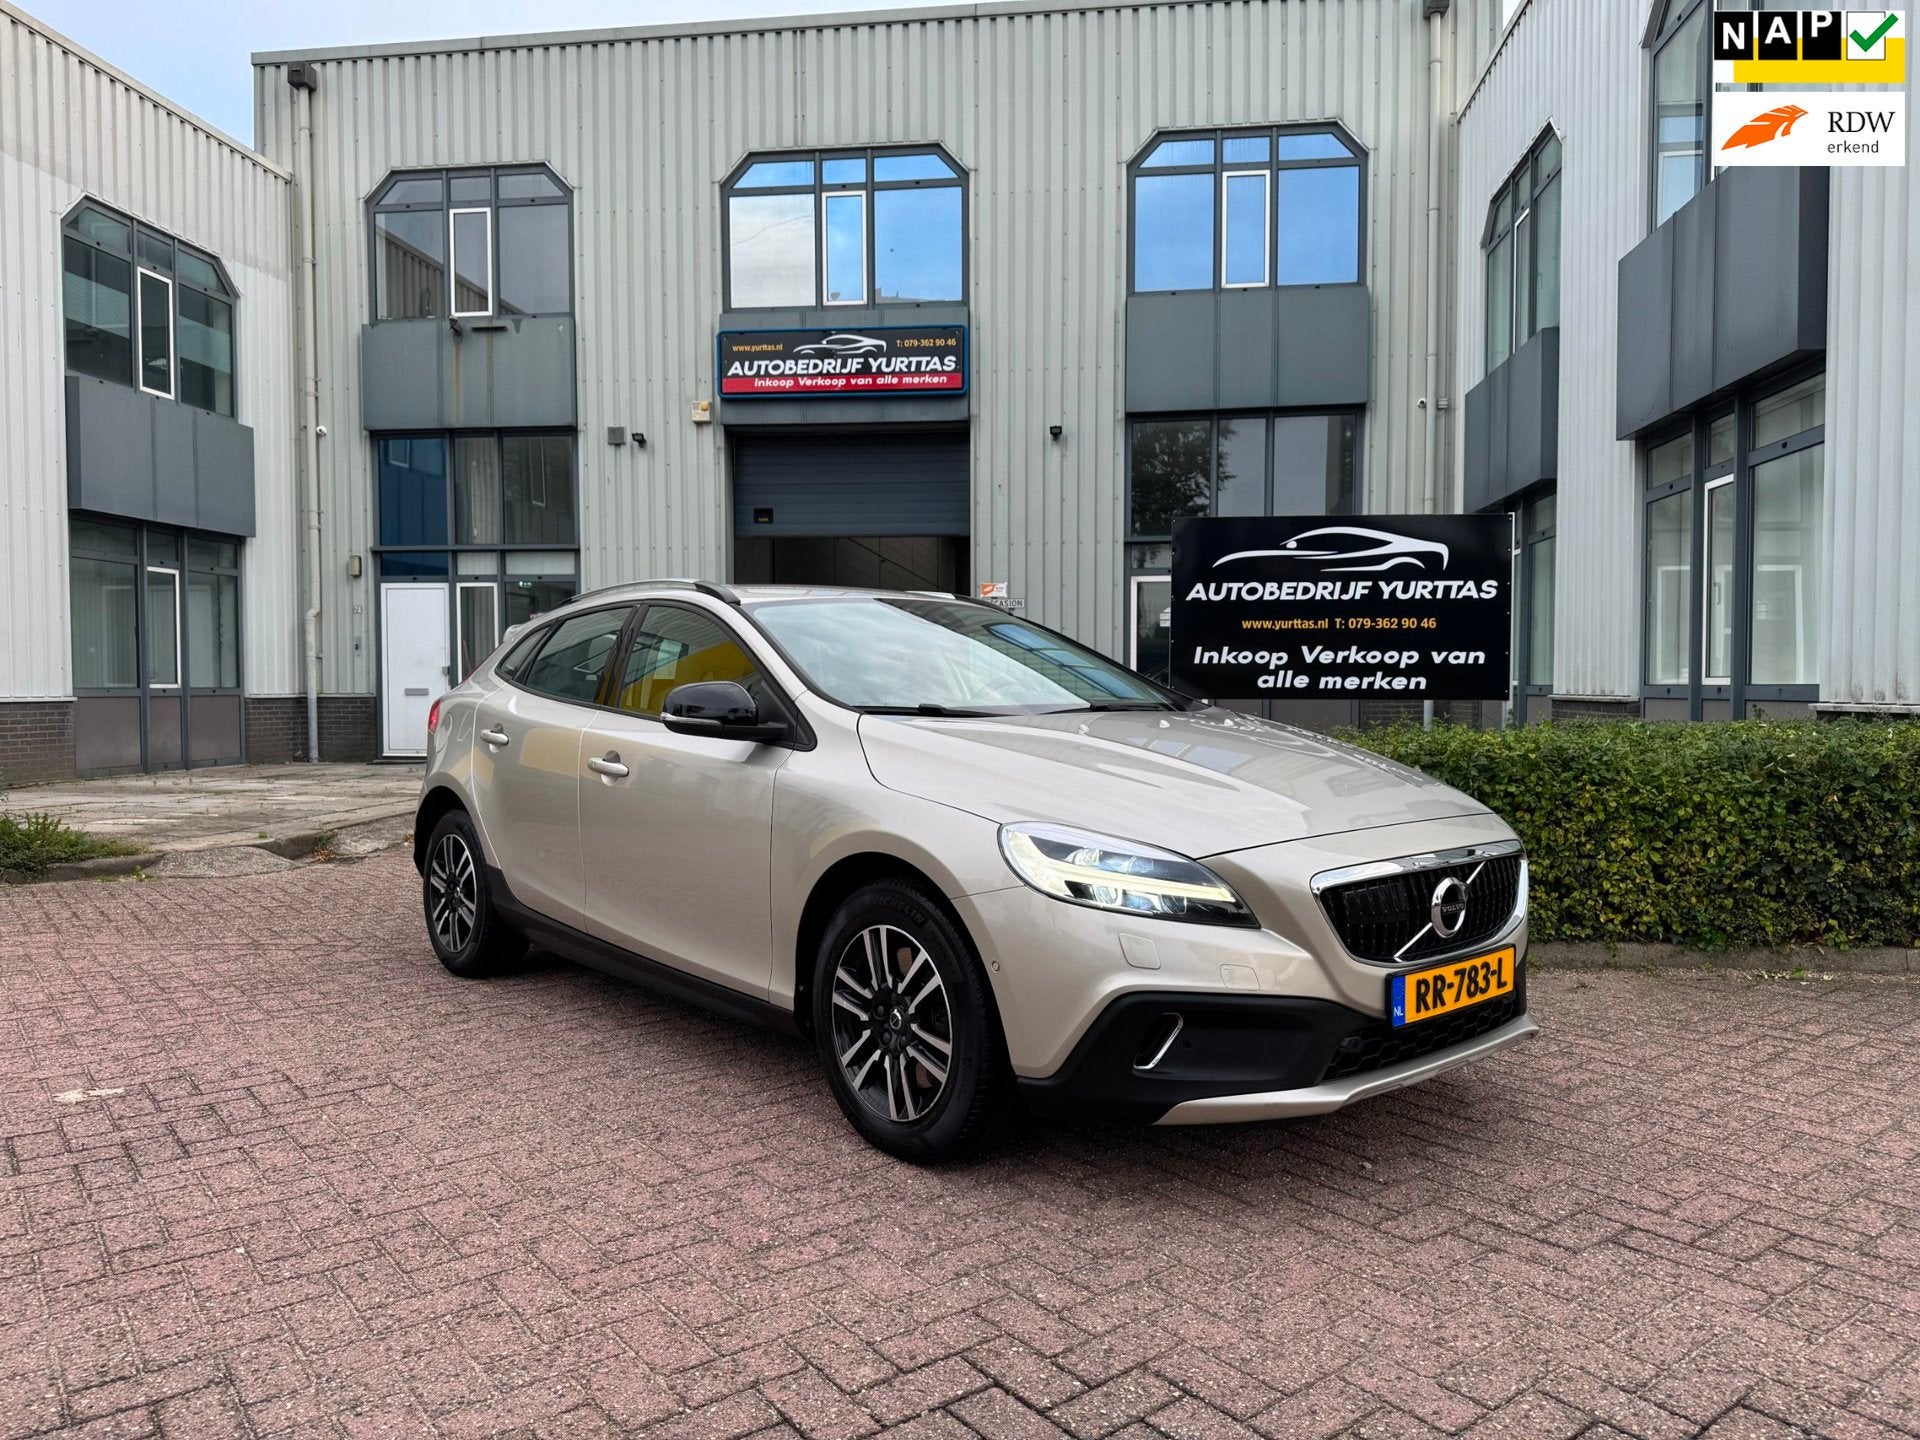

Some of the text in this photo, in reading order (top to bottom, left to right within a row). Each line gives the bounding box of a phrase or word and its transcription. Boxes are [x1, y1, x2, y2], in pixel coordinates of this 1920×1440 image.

[732, 343, 783, 353] www.yurttas.nl
[896, 337, 957, 348] T: 079-362 90 46
[727, 355, 957, 376] AUTOBEDRIJF YURTTAS
[754, 374, 948, 389] Inkoop Verkoop van alle merken
[1186, 580, 1498, 600] AUTOBEDRIJF YURTTAS
[1242, 617, 1437, 631] www.yurttas.nl T: 079-362 90 46
[1193, 645, 1486, 669] Inkoop Verkoop van
[1257, 670, 1427, 690] alle merken
[1441, 902, 1465, 913] VOLVO
[1415, 957, 1508, 1014] RR-783-L
[1393, 1005, 1404, 1017] NL
